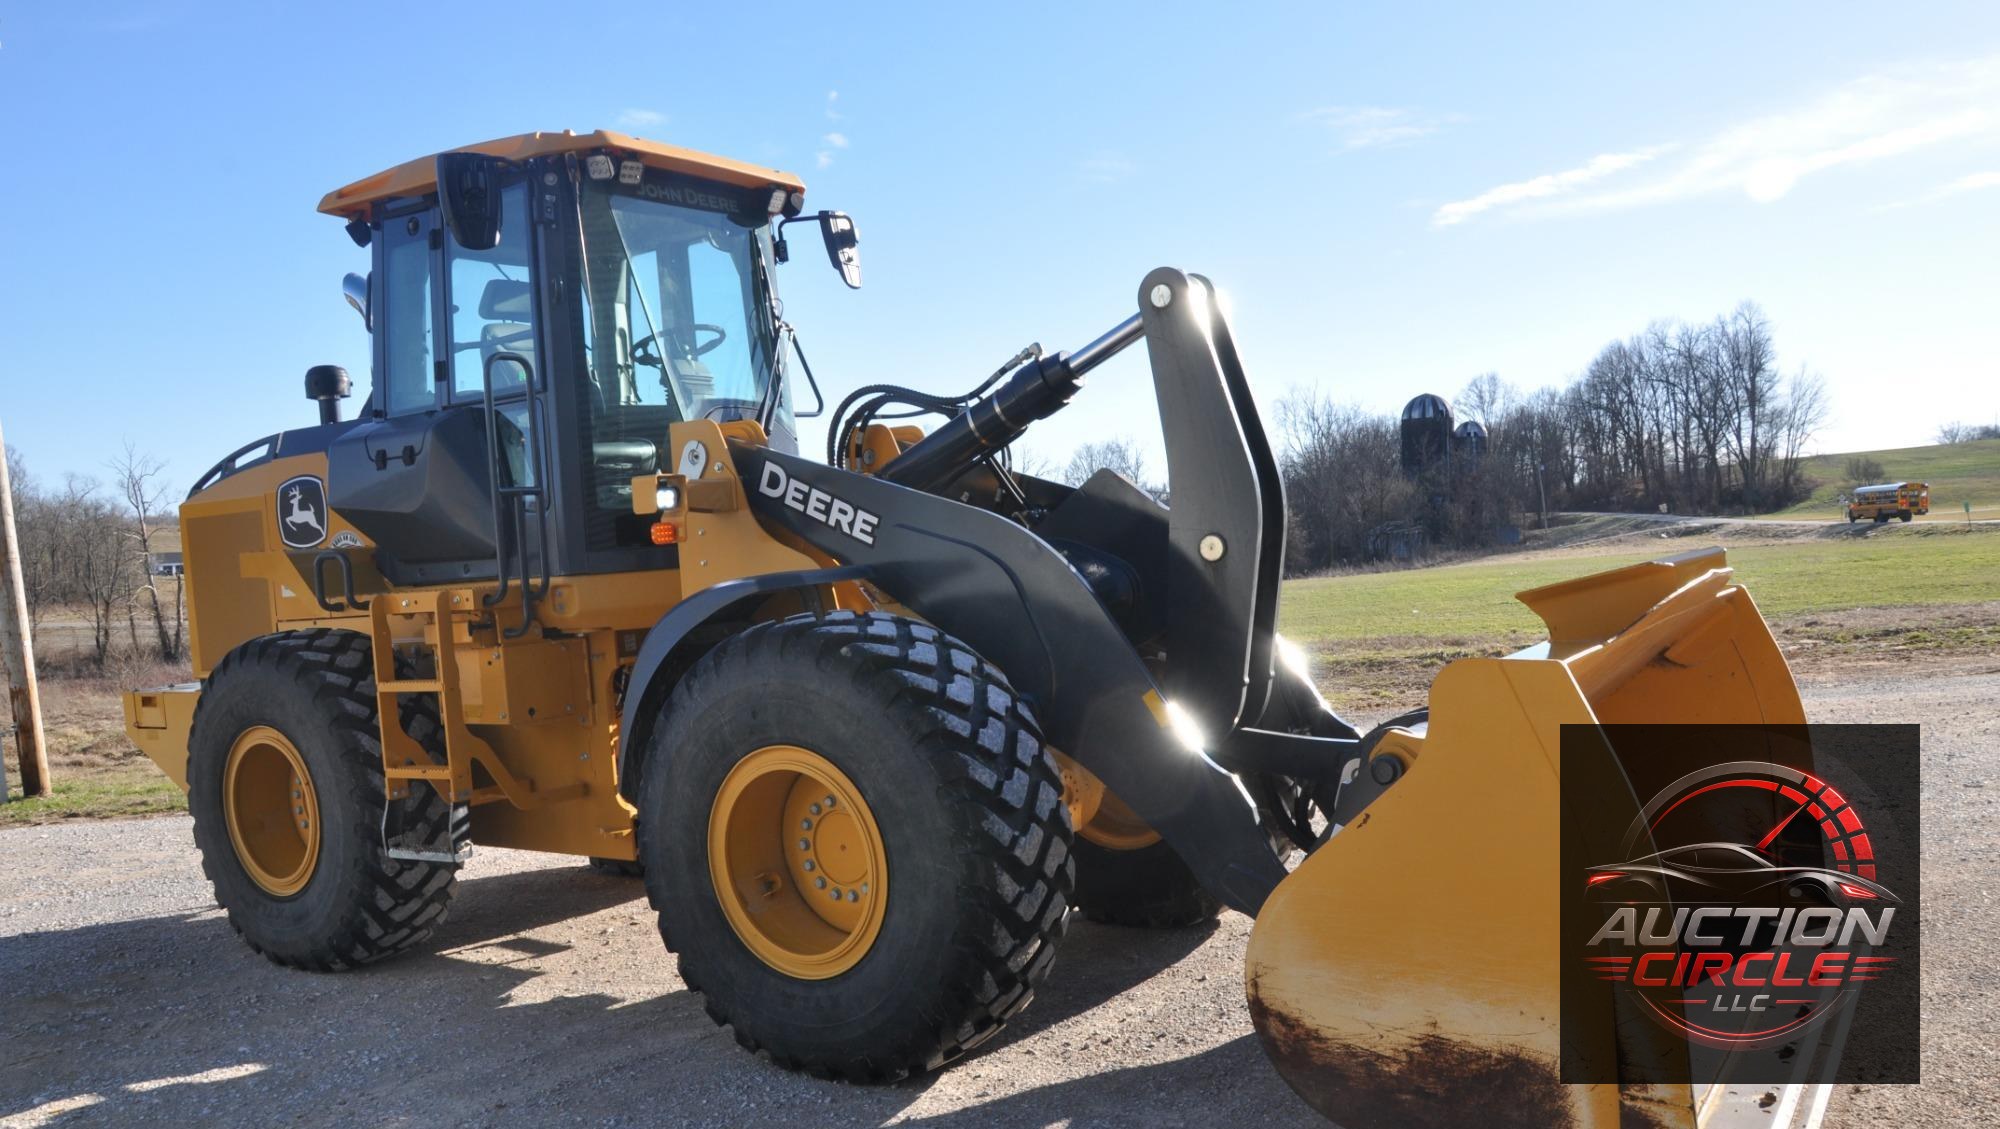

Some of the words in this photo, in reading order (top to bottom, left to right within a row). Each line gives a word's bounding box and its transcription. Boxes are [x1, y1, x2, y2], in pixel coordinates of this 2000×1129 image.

[638, 184, 681, 202] JOHN
[686, 189, 739, 212] DEERE
[759, 460, 879, 545] DEERE
